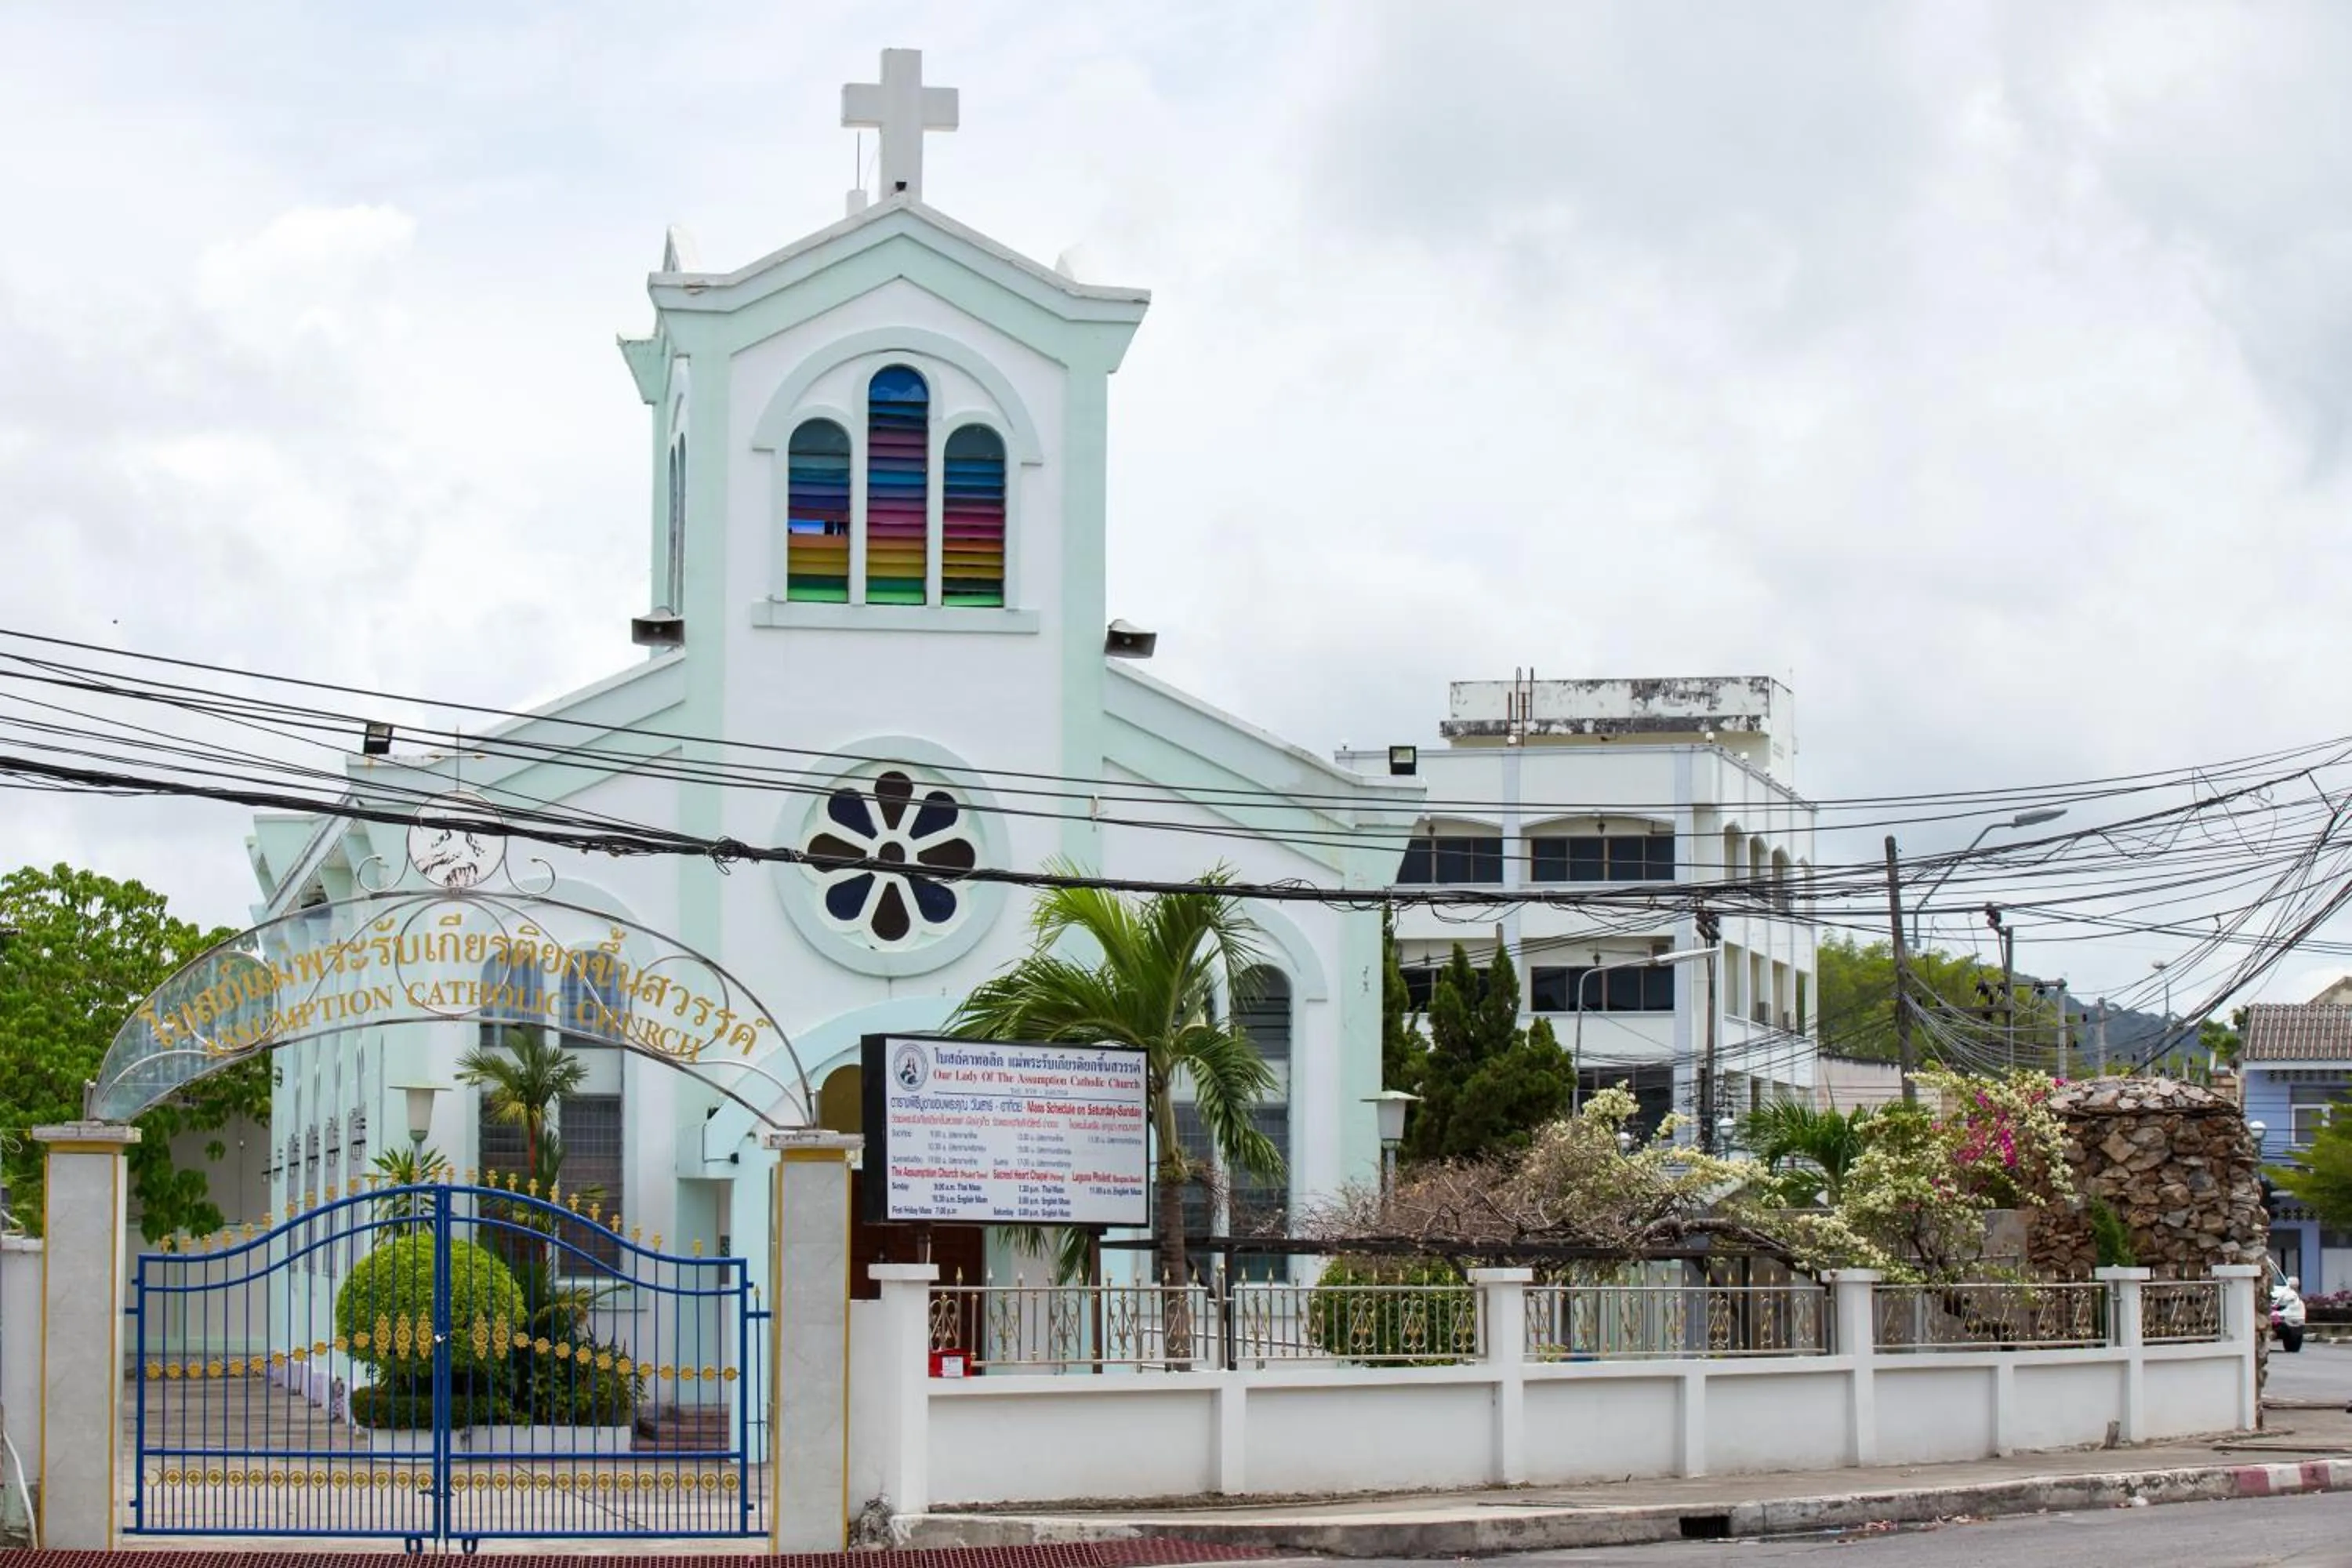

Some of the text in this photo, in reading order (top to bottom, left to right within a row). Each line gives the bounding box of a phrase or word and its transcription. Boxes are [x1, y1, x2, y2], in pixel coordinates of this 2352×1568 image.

[406, 979, 563, 1018] CATHOLIC
[575, 1000, 704, 1063] CHURCH
[933, 1069, 1142, 1089] Our Lady Of The Assumption Catholic Church
[1027, 1101, 1045, 1113] Mass
[1047, 1102, 1075, 1115] Schedule
[1077, 1105, 1086, 1115] on
[891, 1182, 909, 1192] Sunday
